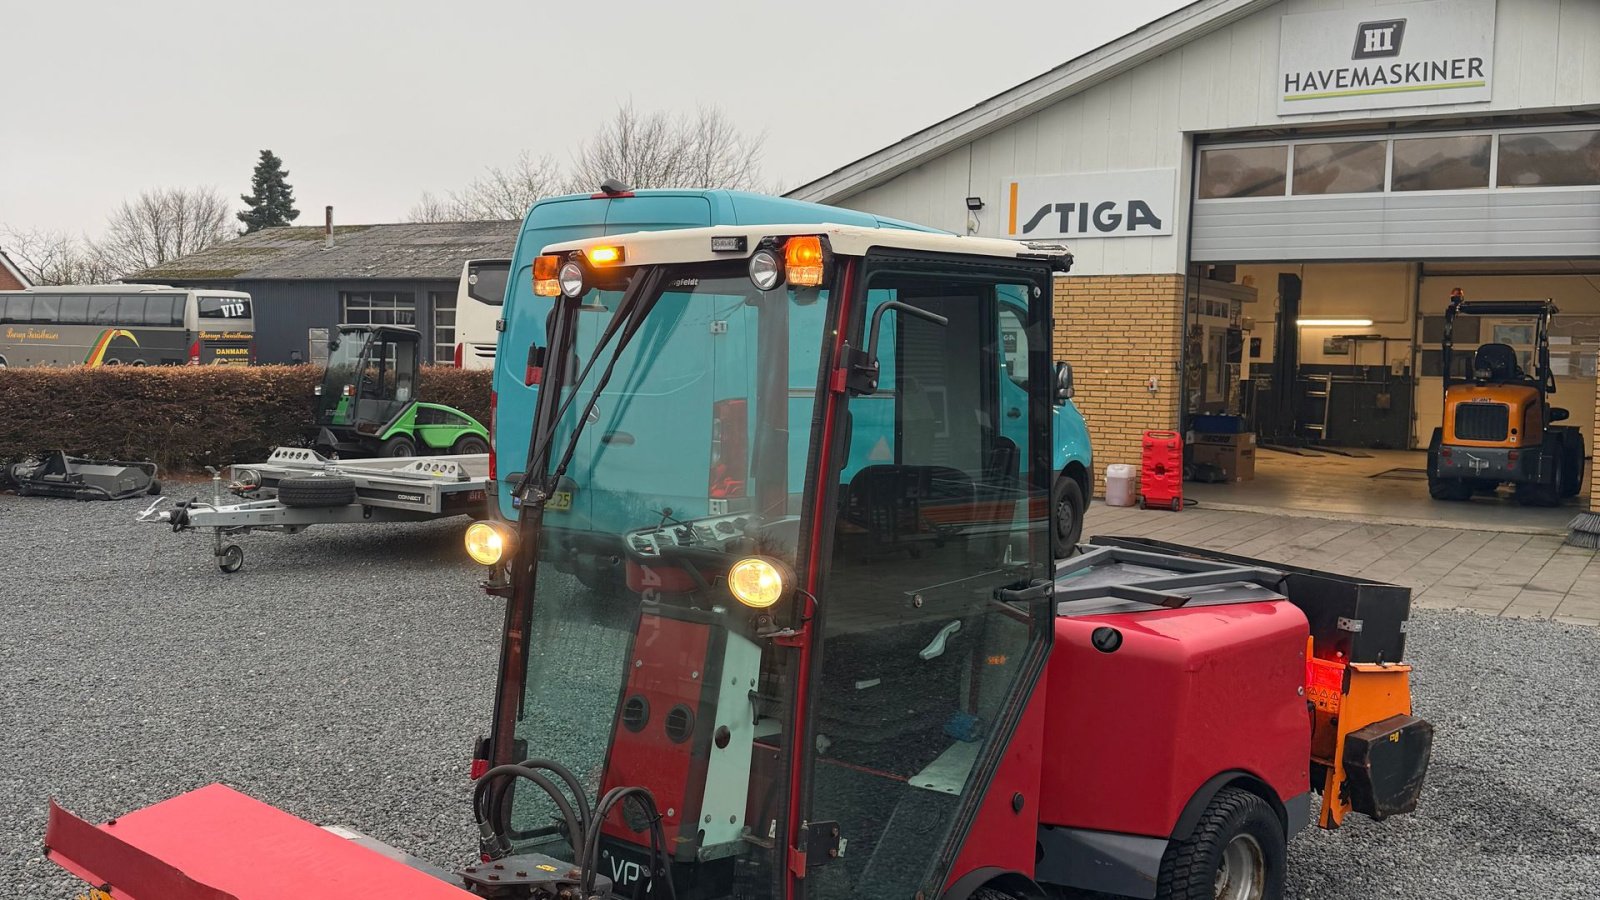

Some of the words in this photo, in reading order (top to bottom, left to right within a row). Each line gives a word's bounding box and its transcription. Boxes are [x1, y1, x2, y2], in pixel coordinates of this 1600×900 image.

[1363, 27, 1395, 53] HI
[1284, 57, 1485, 93] HAVEMASKINER
[1022, 200, 1162, 234] STIGA
[220, 303, 245, 318] VIP
[397, 494, 422, 502] CONNECT
